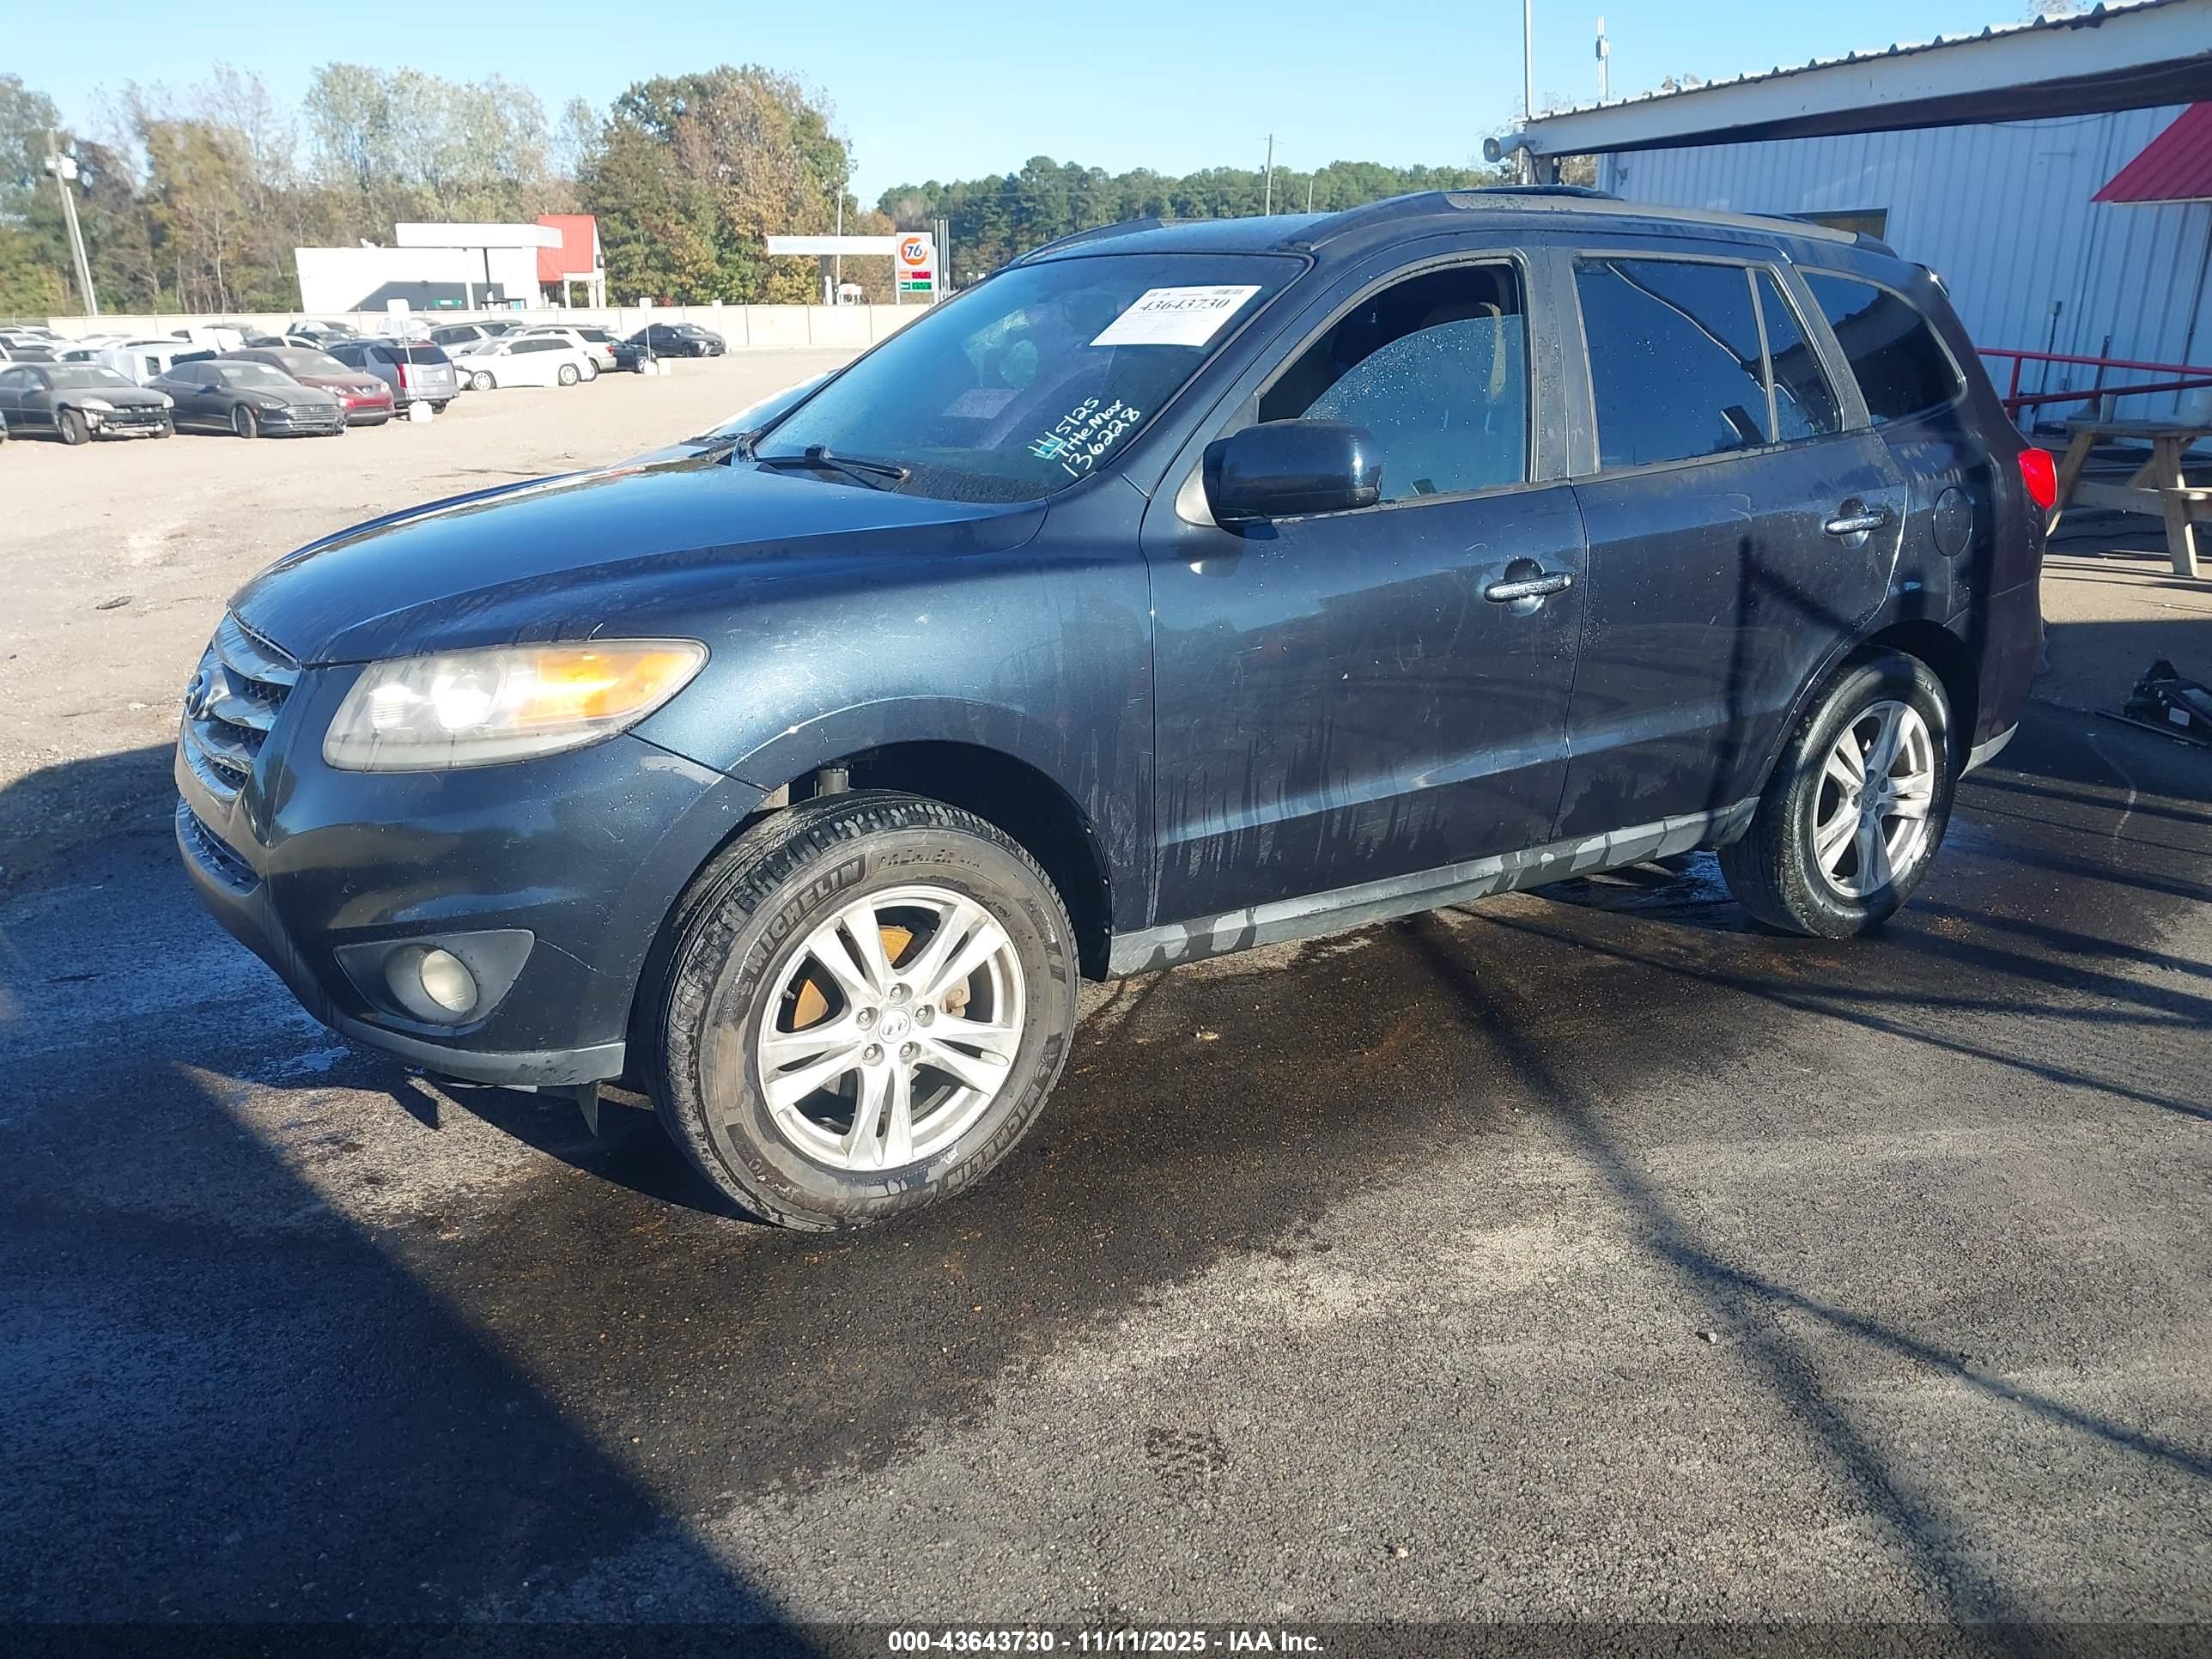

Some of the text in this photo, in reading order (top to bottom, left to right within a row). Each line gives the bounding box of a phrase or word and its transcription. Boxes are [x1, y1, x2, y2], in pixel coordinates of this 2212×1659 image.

[906, 244, 923, 258] 76
[1139, 297, 1231, 312] 43643730
[1061, 407, 1140, 477] 136228
[744, 860, 860, 976] MICHELIN
[946, 1082, 1042, 1191] MICHELIN
